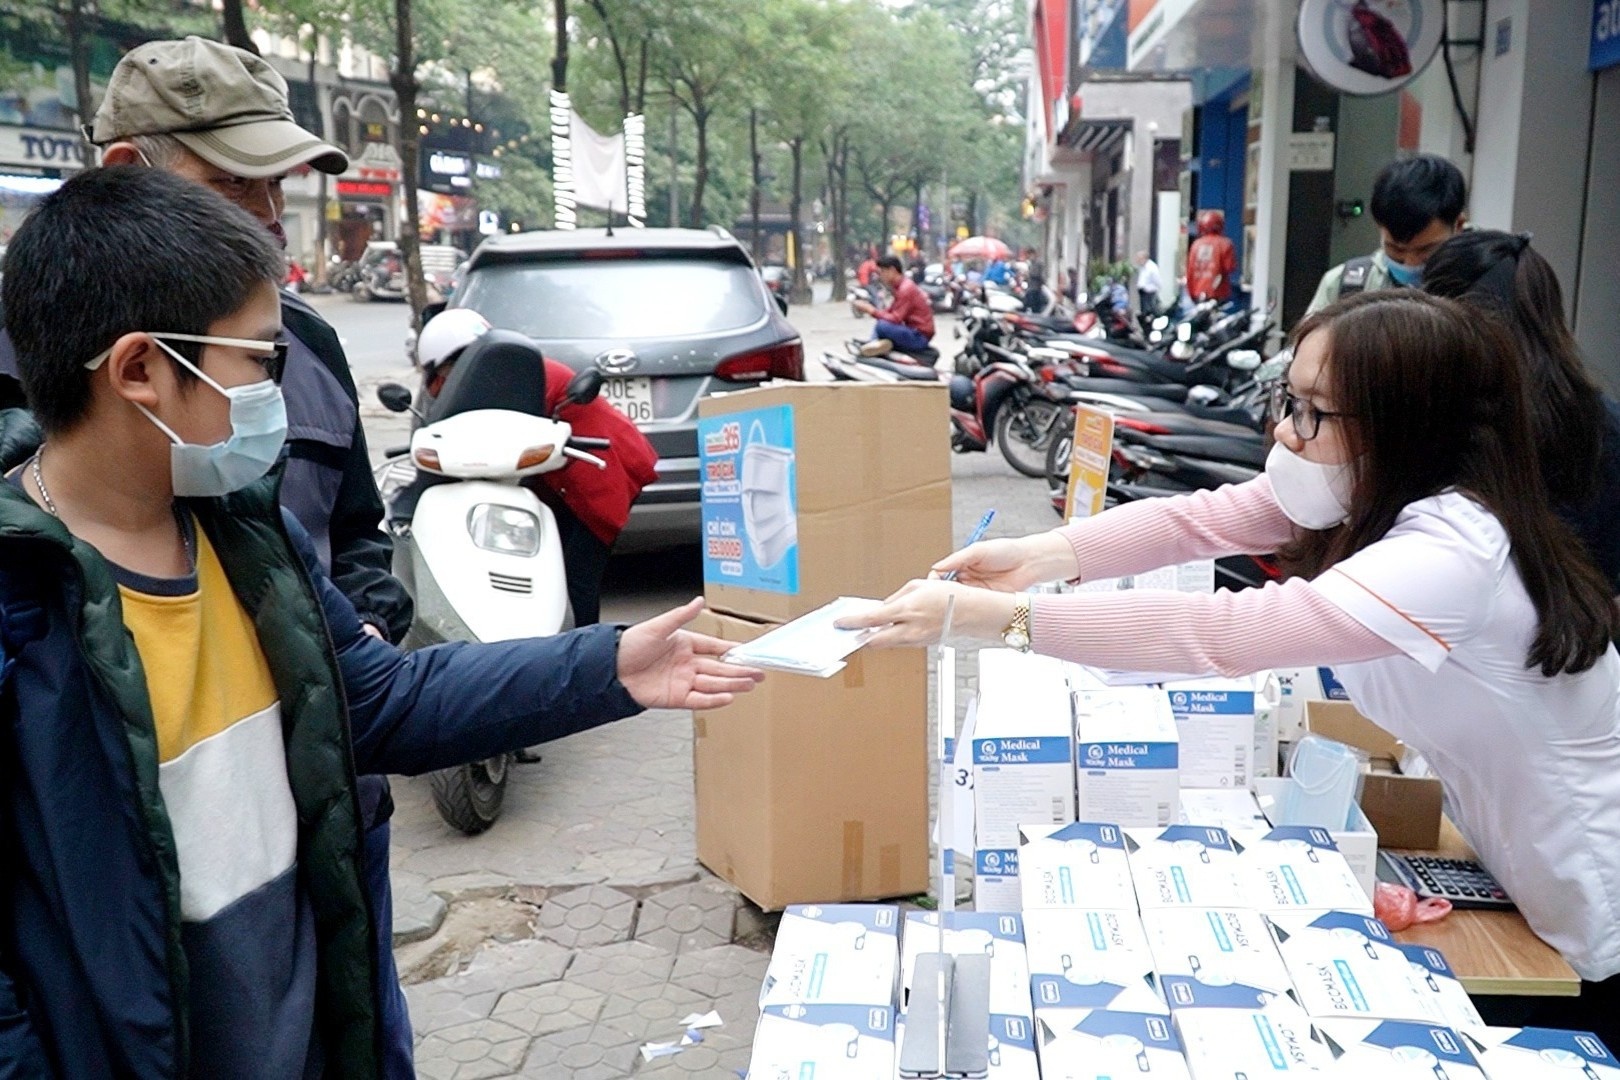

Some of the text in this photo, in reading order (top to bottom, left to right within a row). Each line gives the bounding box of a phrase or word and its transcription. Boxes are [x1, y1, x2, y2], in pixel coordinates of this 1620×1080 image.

[1191, 692, 1228, 702] Medical
[1191, 703, 1216, 713] Mask
[1001, 740, 1041, 751] Medical
[1107, 744, 1149, 755] Medical
[1001, 752, 1029, 763] Mask
[1107, 757, 1136, 768] Mask
